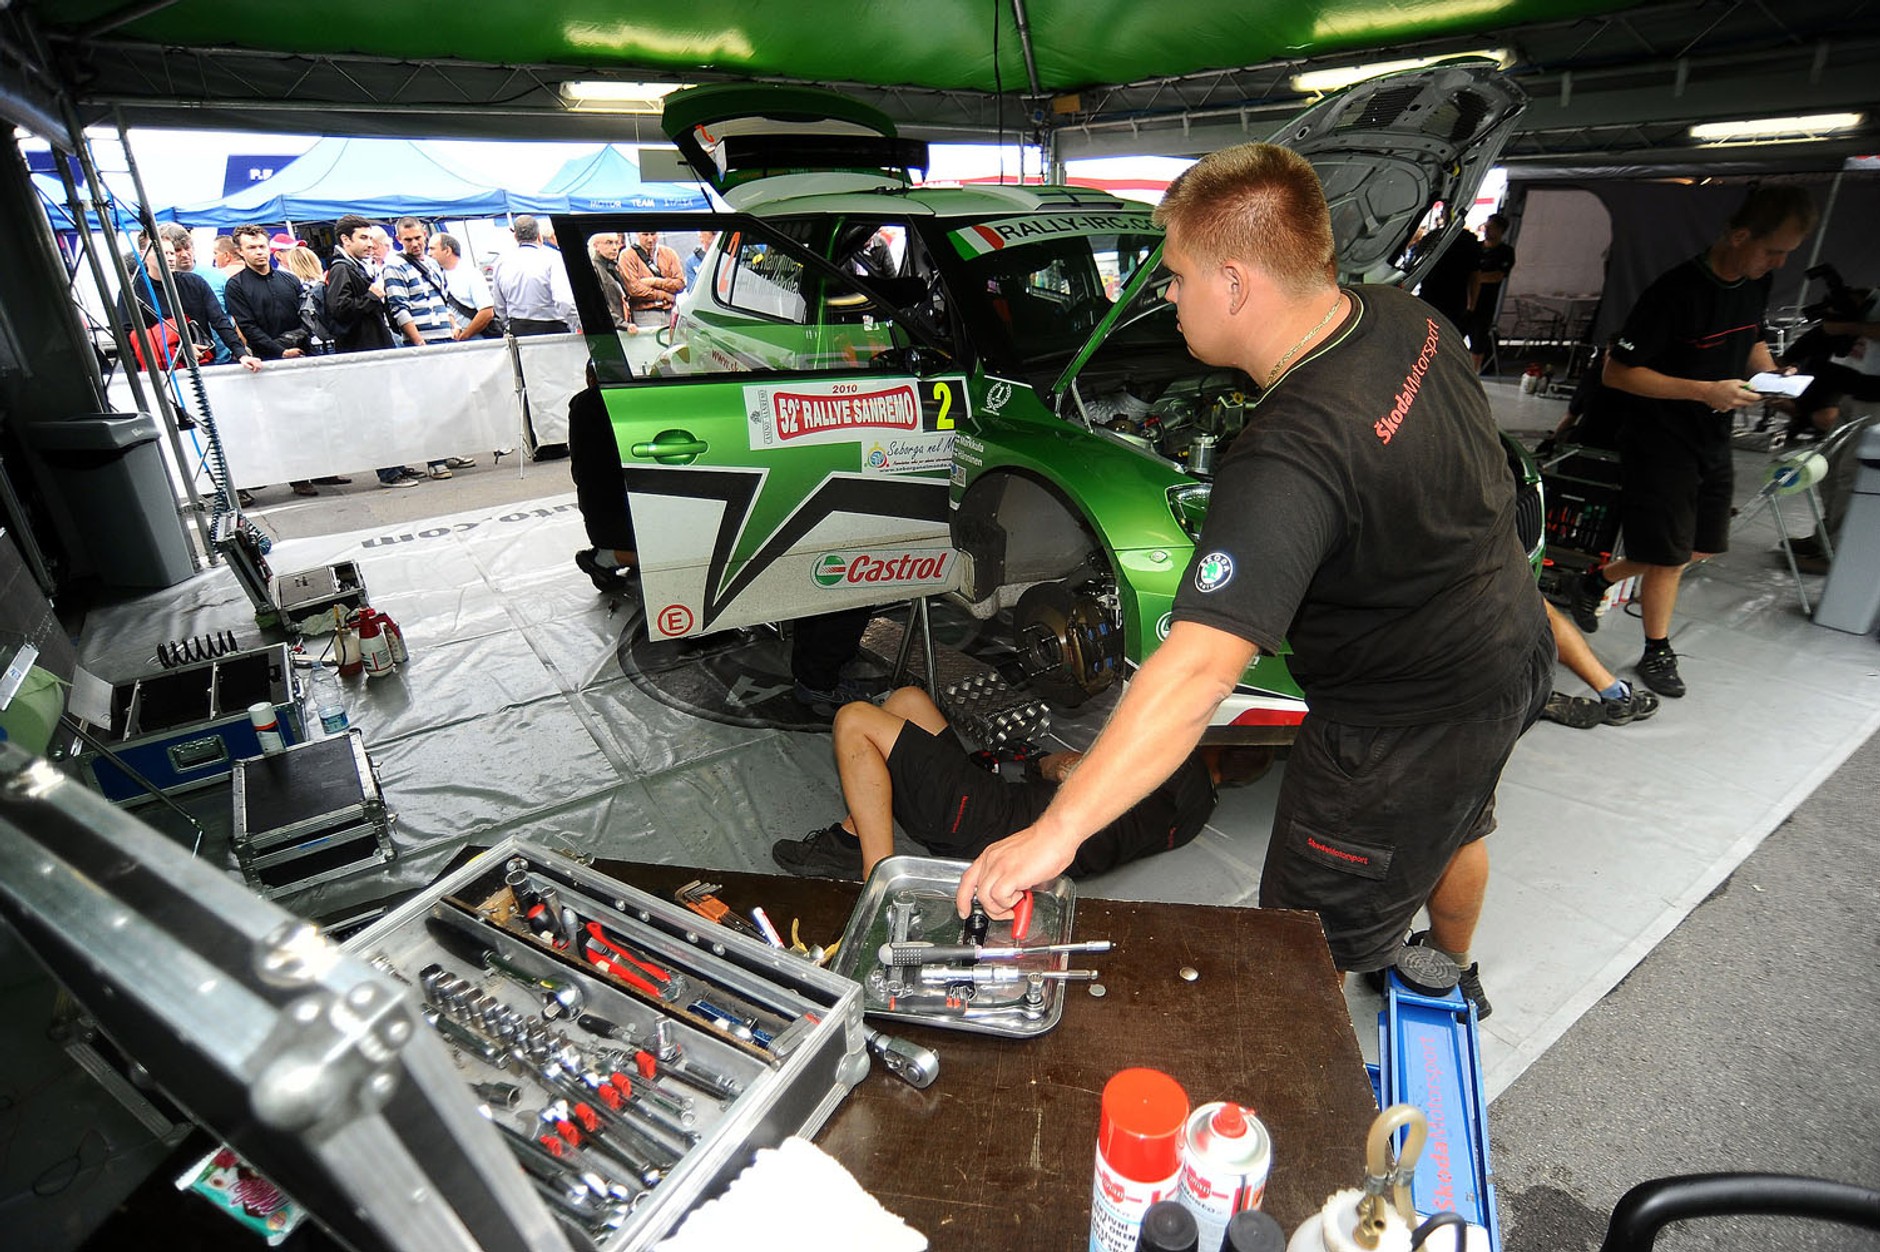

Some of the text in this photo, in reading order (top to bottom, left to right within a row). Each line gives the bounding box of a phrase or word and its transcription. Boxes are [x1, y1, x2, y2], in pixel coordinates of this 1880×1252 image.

[631, 198, 656, 208] TEAM
[832, 384, 858, 394] 2010
[803, 400, 852, 429] RALLYE
[853, 391, 914, 424] SANREMO
[933, 381, 955, 430] 2
[927, 437, 943, 453] nel
[847, 552, 948, 583] Castrol
[667, 612, 684, 631] E
